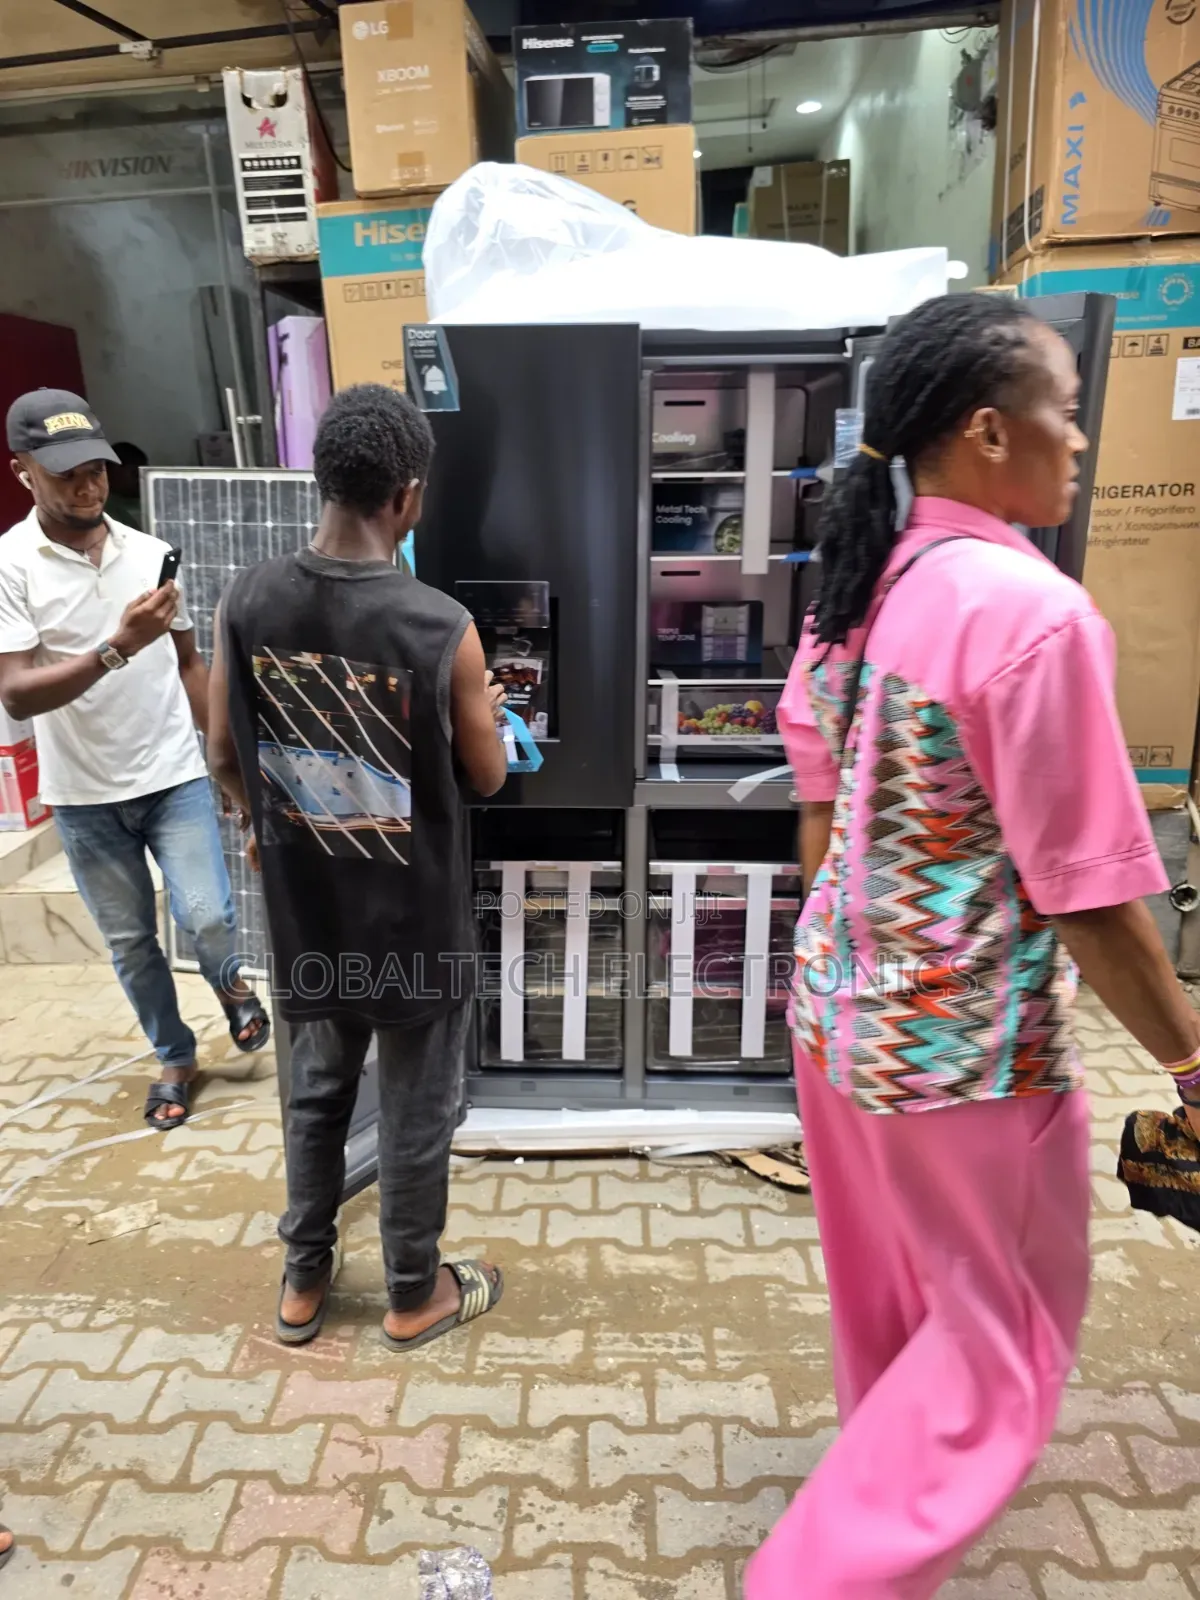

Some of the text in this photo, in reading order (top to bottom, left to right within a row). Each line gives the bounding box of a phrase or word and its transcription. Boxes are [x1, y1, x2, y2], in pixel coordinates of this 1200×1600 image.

[369, 21, 389, 35] LG
[522, 37, 575, 49] Hisense
[376, 65, 430, 83] XBOOM
[1061, 124, 1084, 224] MAXI
[354, 219, 427, 248] Hise
[407, 328, 437, 340] Door
[1187, 338, 1200, 348] BA
[651, 431, 697, 446] Cooling
[1092, 482, 1196, 499] RIGERATOR
[656, 505, 708, 514] Metal Tech
[655, 515, 694, 526] Cooling
[1091, 522, 1112, 532] ank
